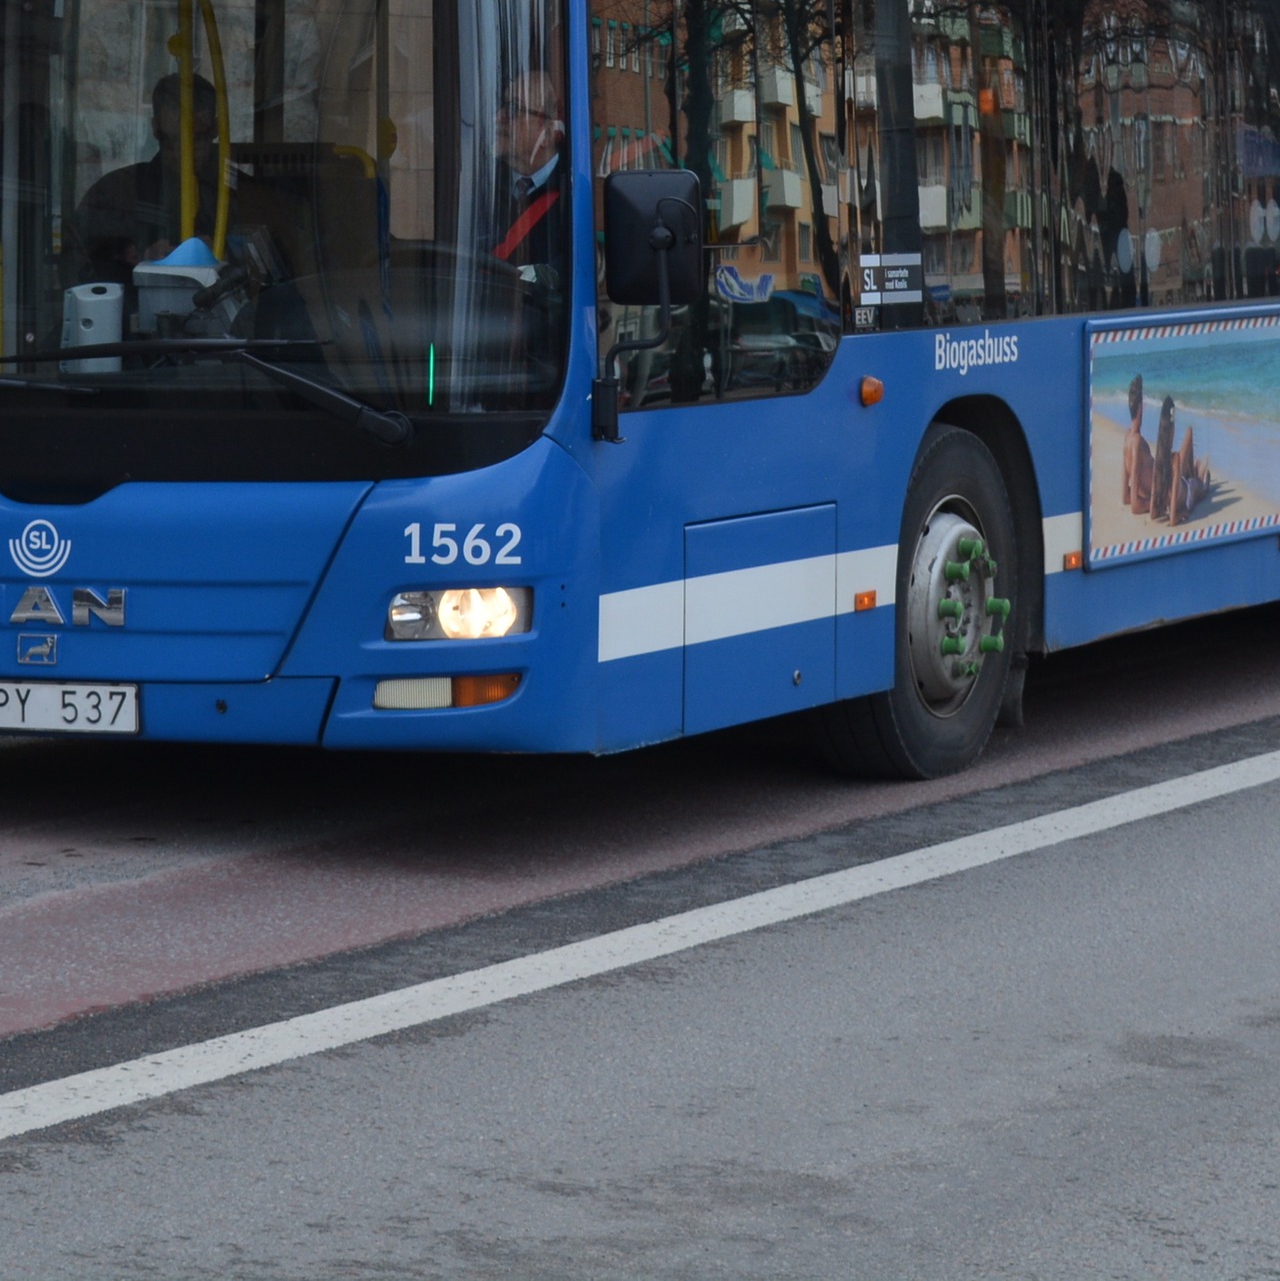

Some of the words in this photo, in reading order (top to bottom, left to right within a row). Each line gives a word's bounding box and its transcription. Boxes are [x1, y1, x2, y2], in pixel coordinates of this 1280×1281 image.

[864, 269, 877, 290] SL
[855, 309, 874, 325] EEV
[935, 329, 1018, 375] Biogasbuss
[29, 531, 52, 550] SL
[404, 522, 522, 566] 1562
[61, 690, 127, 726] 537
